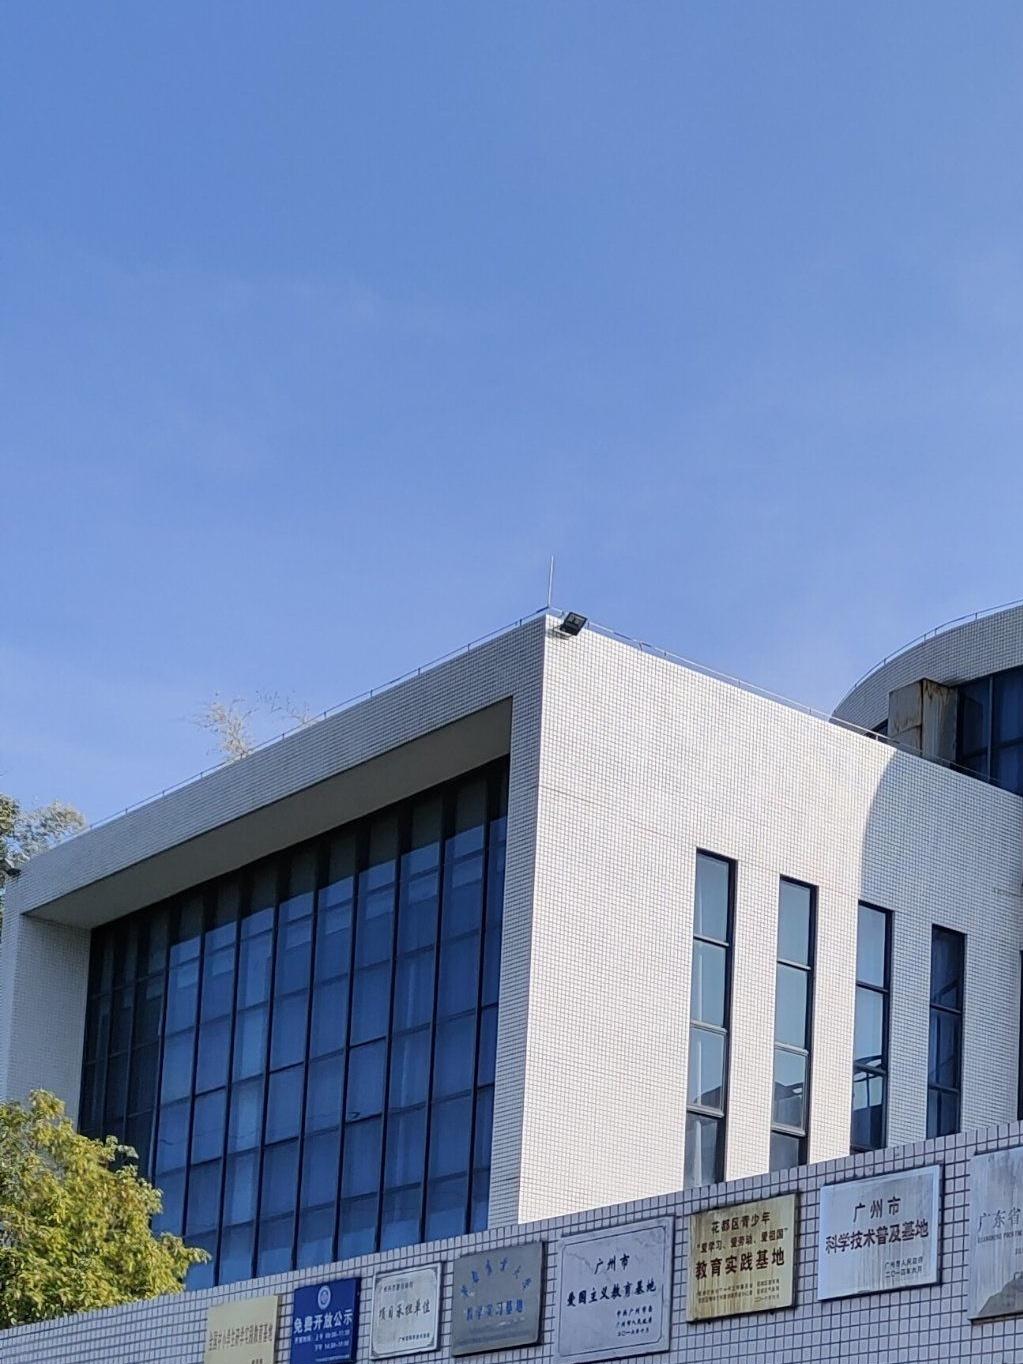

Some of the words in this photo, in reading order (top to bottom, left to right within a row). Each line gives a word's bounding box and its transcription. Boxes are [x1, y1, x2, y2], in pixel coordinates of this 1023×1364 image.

[711, 1211, 770, 1235] 花都区青少年
[853, 1196, 901, 1223] 广州市
[825, 1218, 929, 1254] 科学技术普及基地
[594, 1253, 630, 1275] 广州市
[695, 1247, 785, 1280] 教育实践基地
[566, 1277, 657, 1307] 爱国主义教育基地
[293, 1308, 353, 1334] 免费开放公示
